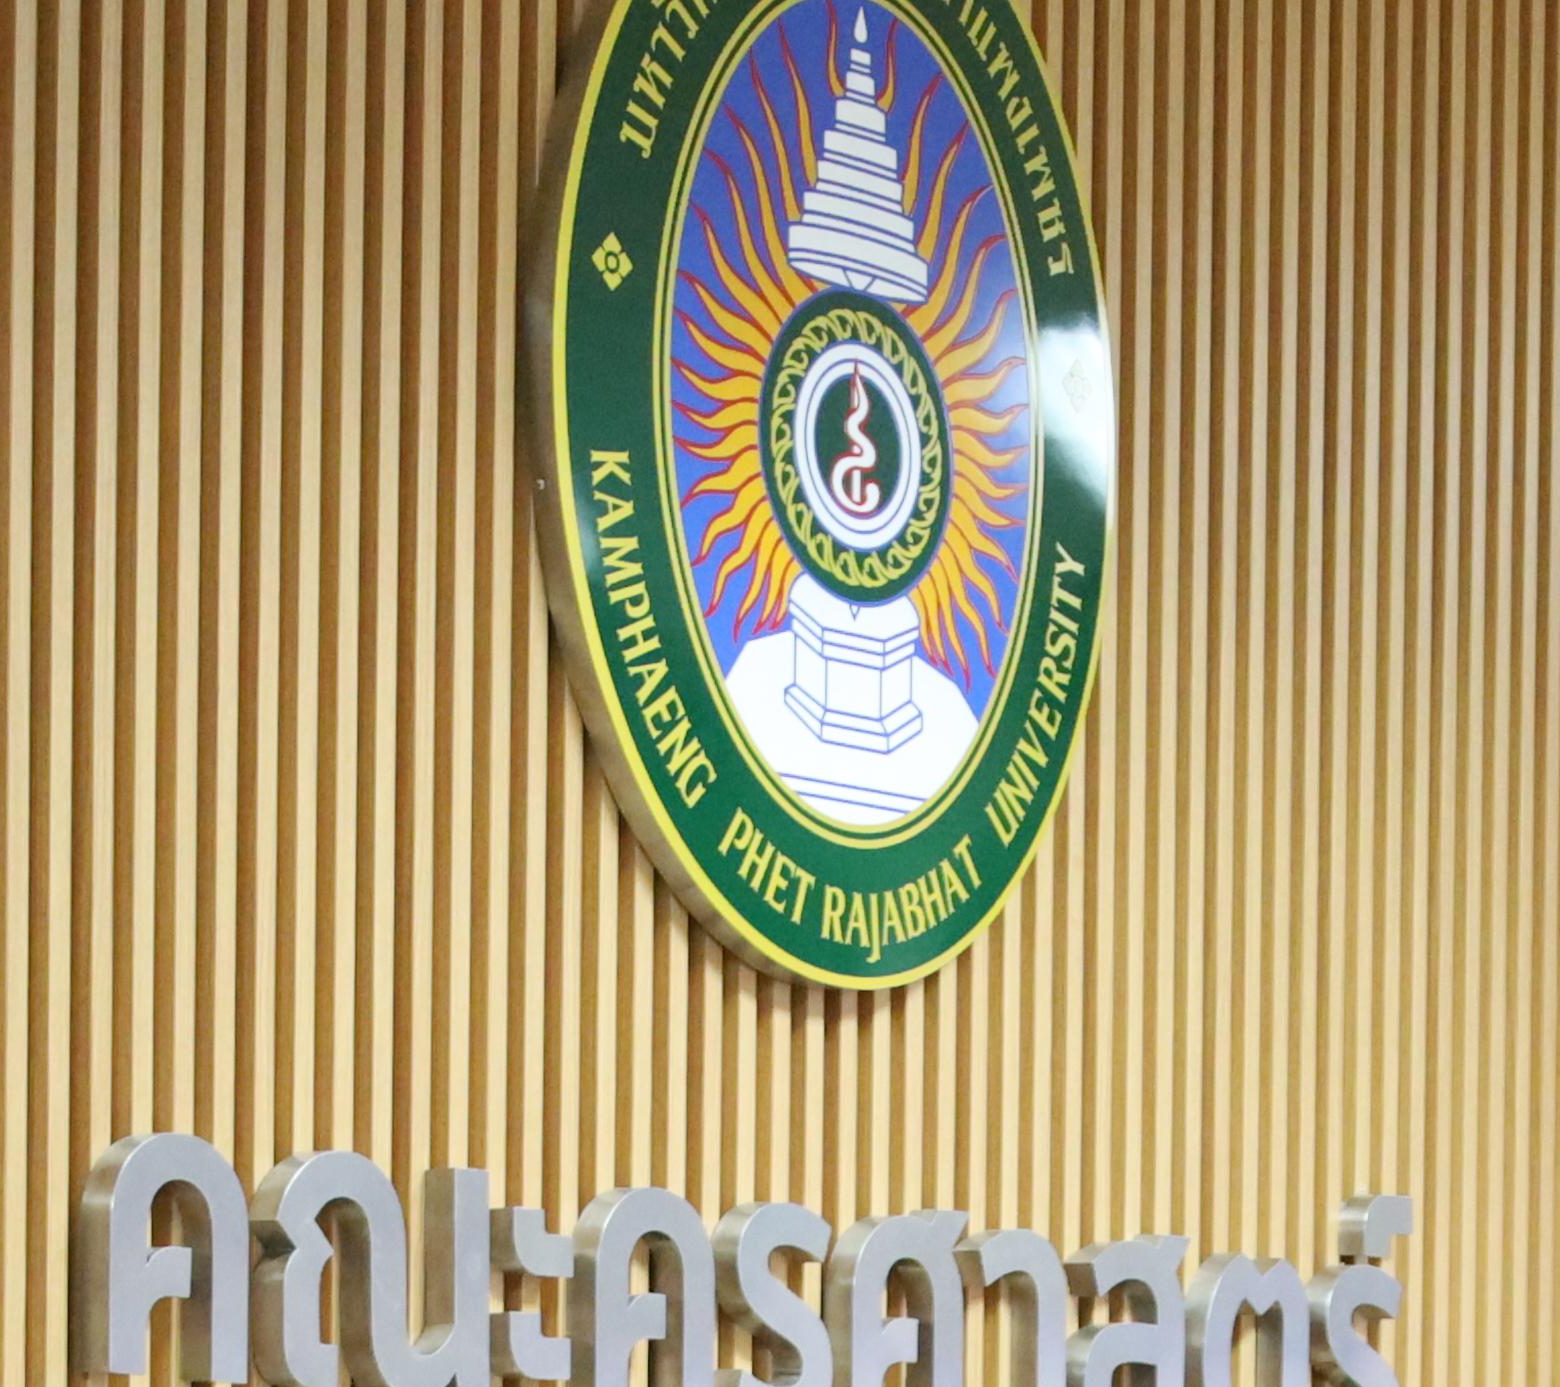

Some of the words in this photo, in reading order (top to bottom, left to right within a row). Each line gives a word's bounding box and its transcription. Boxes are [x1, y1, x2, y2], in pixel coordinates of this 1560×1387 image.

[590, 447, 718, 809] KAMPHAENG
[718, 806, 818, 928] PHET
[820, 833, 984, 966] RAJABHAT
[986, 541, 1087, 847] UNIVERSITY
